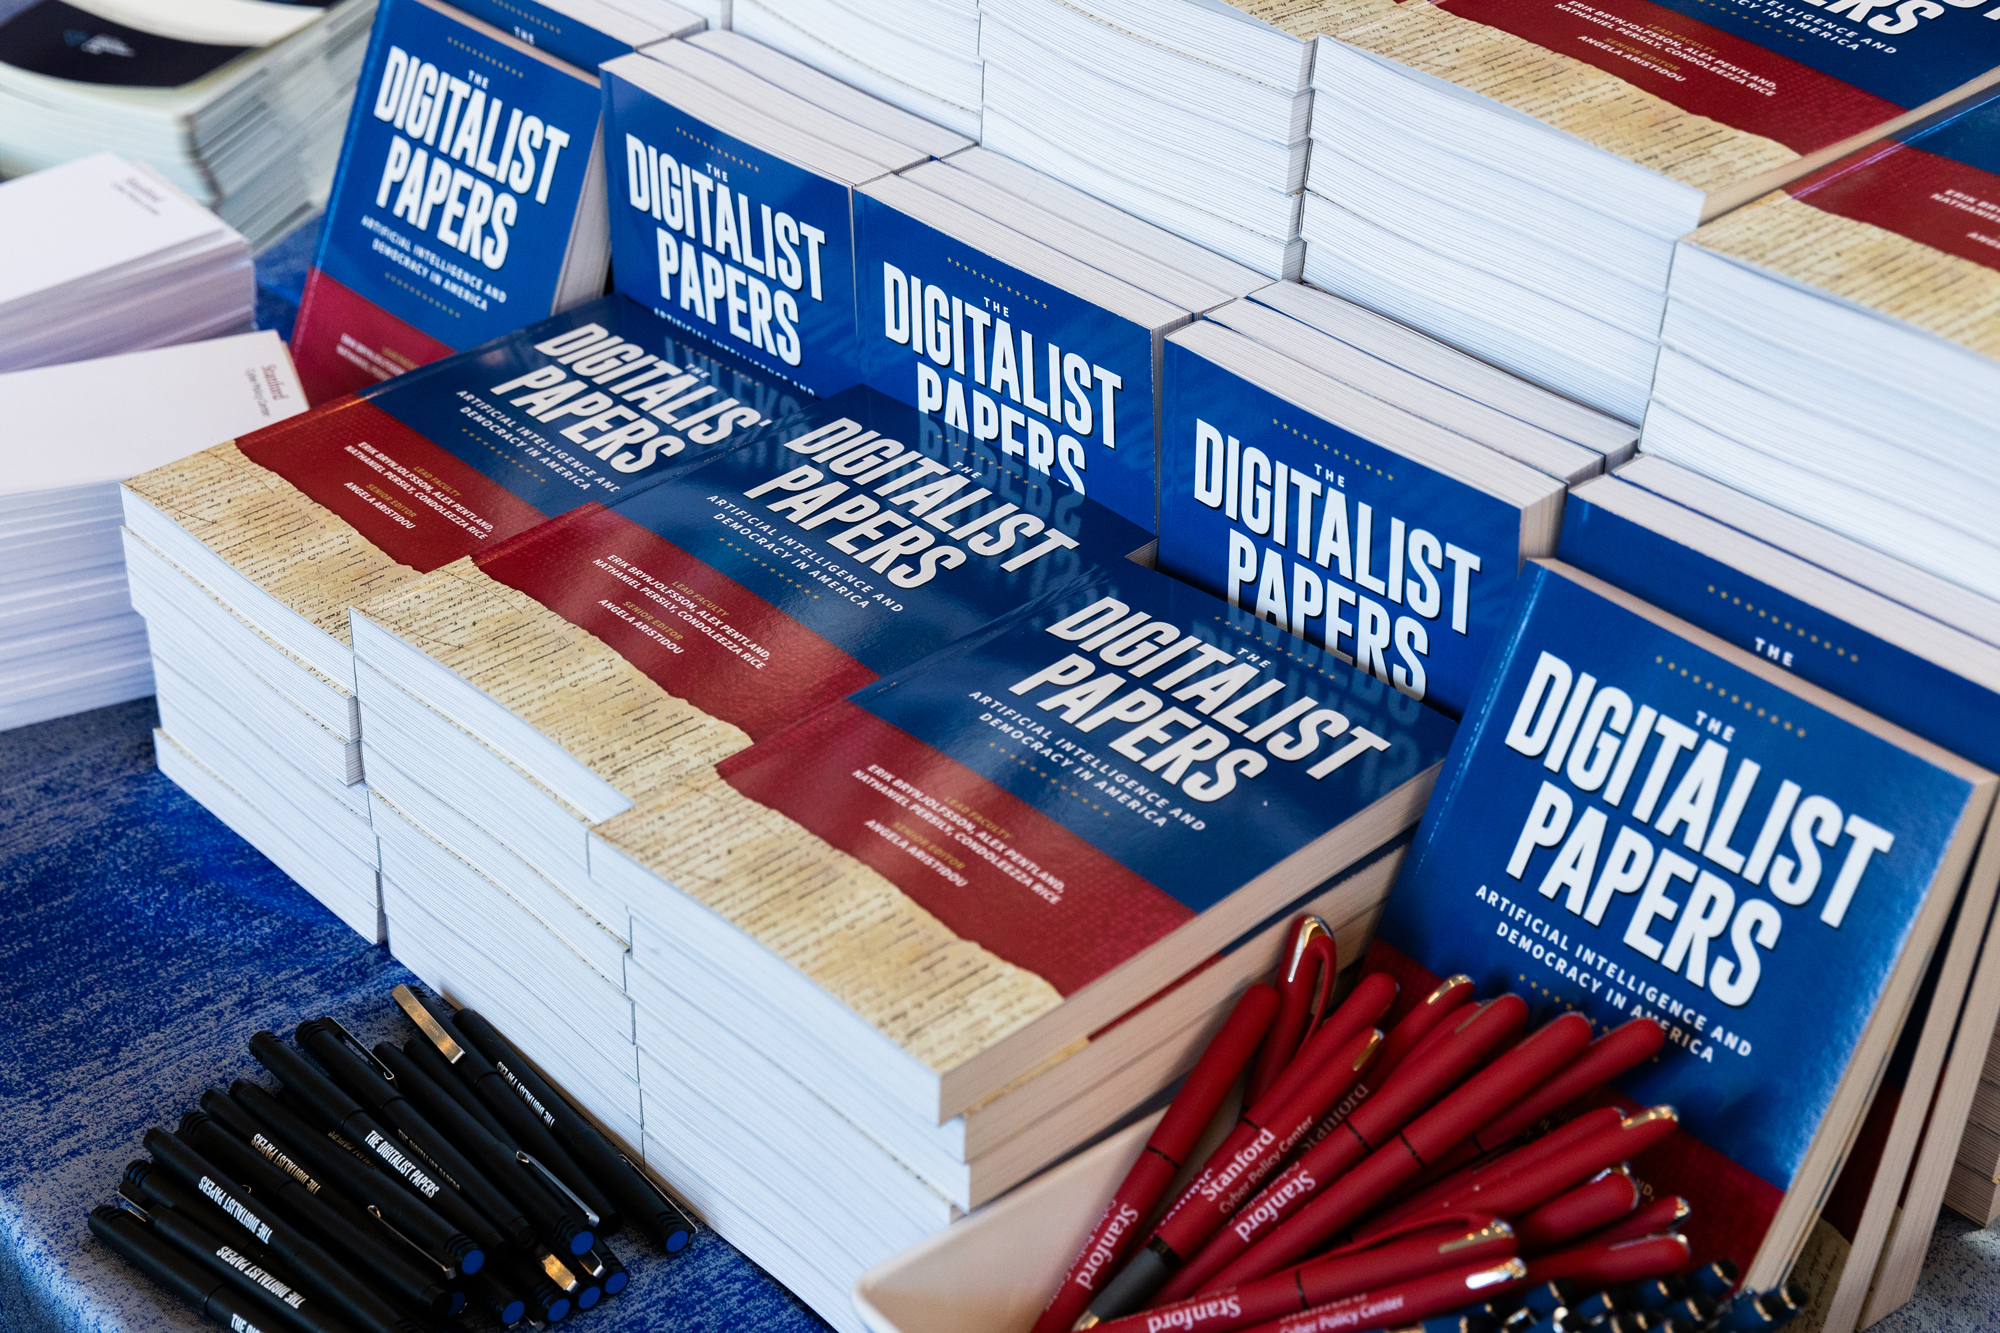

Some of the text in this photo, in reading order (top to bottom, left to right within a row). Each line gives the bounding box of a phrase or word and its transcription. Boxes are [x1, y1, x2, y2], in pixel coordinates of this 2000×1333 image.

[514, 26, 535, 44] THE
[1554, 3, 1778, 97] NATHANIEL PERSILY, CONDOLEEZZA RICE
[1568, 0, 1777, 91] ERIK BRYNJOLFSSON, ALEX PENTLAND,
[1577, 35, 1687, 83] ANGELA ARISTIDOU
[1603, 37, 1680, 71] SENIOR EDITOR
[1646, 23, 1718, 54] LEAD FACULTY
[1760, 0, 1859, 38] ELLIGENCE
[1860, 37, 1897, 54] AND
[1762, 8, 1783, 19] IN
[1784, 17, 1860, 51] AMERICA
[468, 69, 489, 89] THE
[373, 45, 570, 204] DIGITALIST
[375, 135, 518, 270] PAPERS
[706, 162, 728, 182] THE
[360, 214, 507, 303] ARTIFICIAL INTELLIGENCE AND
[625, 132, 826, 302] DIGITALIST
[372, 238, 488, 312] DEMOCRACY IN AMERICA
[656, 226, 801, 366] PAPERS
[984, 296, 1010, 319] THE
[534, 322, 772, 445] DIGITALIS
[685, 363, 711, 379] THE
[883, 261, 1122, 449] DIGITALIST
[456, 390, 517, 428] ARTIFICIAL
[516, 426, 597, 478] INTELLIGENCE
[459, 406, 592, 491] DEMOCRACY IN AMERICA
[490, 364, 686, 474] PAPERS
[917, 361, 1086, 496] PAPERS
[344, 445, 489, 541] NATHANIEL PERSILY, CONDOLEEZZA RICE
[344, 481, 416, 530] ANGELA ARISTIDOU
[357, 441, 494, 533] ERIK BRYNJOLFSSON, ALEX PENTLAND,
[366, 483, 418, 519] SENIOR EDITOR
[413, 466, 462, 498] LEAD FACULTY
[783, 416, 1080, 572] DIGITALIST
[952, 461, 983, 479] THE
[1314, 462, 1346, 488] THE
[706, 494, 904, 613] ARTIFICIAL INTELLIGENCE AND
[713, 512, 870, 609] DEMOCRACY IN AMERICA
[742, 464, 967, 588] PAPERS
[1193, 418, 1481, 634] DIGITALIST
[592, 558, 767, 670] NATHANIEL PERSILY, CONDOLEEZZA RICE
[598, 598, 685, 655] ANGELA ARISTIDOU
[607, 554, 771, 661] ERIK BRYNJOLFSSON, ALEX PENTLAND,
[622, 600, 684, 641] SENIOR EDITOR
[671, 580, 730, 617] LEAD FACULTY
[1227, 527, 1428, 700] PAPERS
[1045, 596, 1391, 779] DIGITALIST
[1237, 647, 1272, 669] THE
[1754, 636, 1794, 667] THE
[968, 691, 1207, 831] ARTIFICIAL INTELLIGENCE AND
[1008, 652, 1268, 802] PAPERS
[1695, 709, 1737, 742] THE
[978, 712, 1169, 827] DEMOCRACY IN AMERICA
[1504, 650, 1895, 928] DIGITALIST
[851, 769, 1063, 905] NATHANIEL PERSILY, CONDOLEEZZA RICE
[864, 818, 970, 888] ANGELA ARISTIDOU
[867, 764, 1065, 894] ERIK BRYNJOLFSSON, ALEX PENTLAND,
[891, 821, 966, 871] SENIOR EDITOR
[943, 796, 1013, 840] LEAD FACULTY
[1506, 779, 1783, 1006] PAPERS
[1475, 884, 1752, 1057] ARTIFICIAL INTELLIGENCE AND
[1496, 921, 1602, 994] DEMOCRACY
[1605, 988, 1627, 1010] IN
[250, 1133, 321, 1195] THE DIGITALIST PAPERS
[364, 1129, 384, 1149] THE
[376, 1138, 416, 1177] DIGITALIST
[408, 1169, 440, 1198] PAPERS
[1200, 1127, 1276, 1202] Stanford
[1218, 1181, 1250, 1214] Cyber
[1247, 1150, 1281, 1184] Policy
[1278, 1115, 1313, 1153] Center
[1235, 1169, 1316, 1243] Stanford
[198, 1175, 274, 1244] THE DIGITALIST PAPERS
[1075, 1203, 1139, 1290] Stanford
[216, 1245, 306, 1310] THE DIGITALIST PAPERS
[1147, 1295, 1241, 1333] Stanford
[231, 1313, 247, 1333] THE
